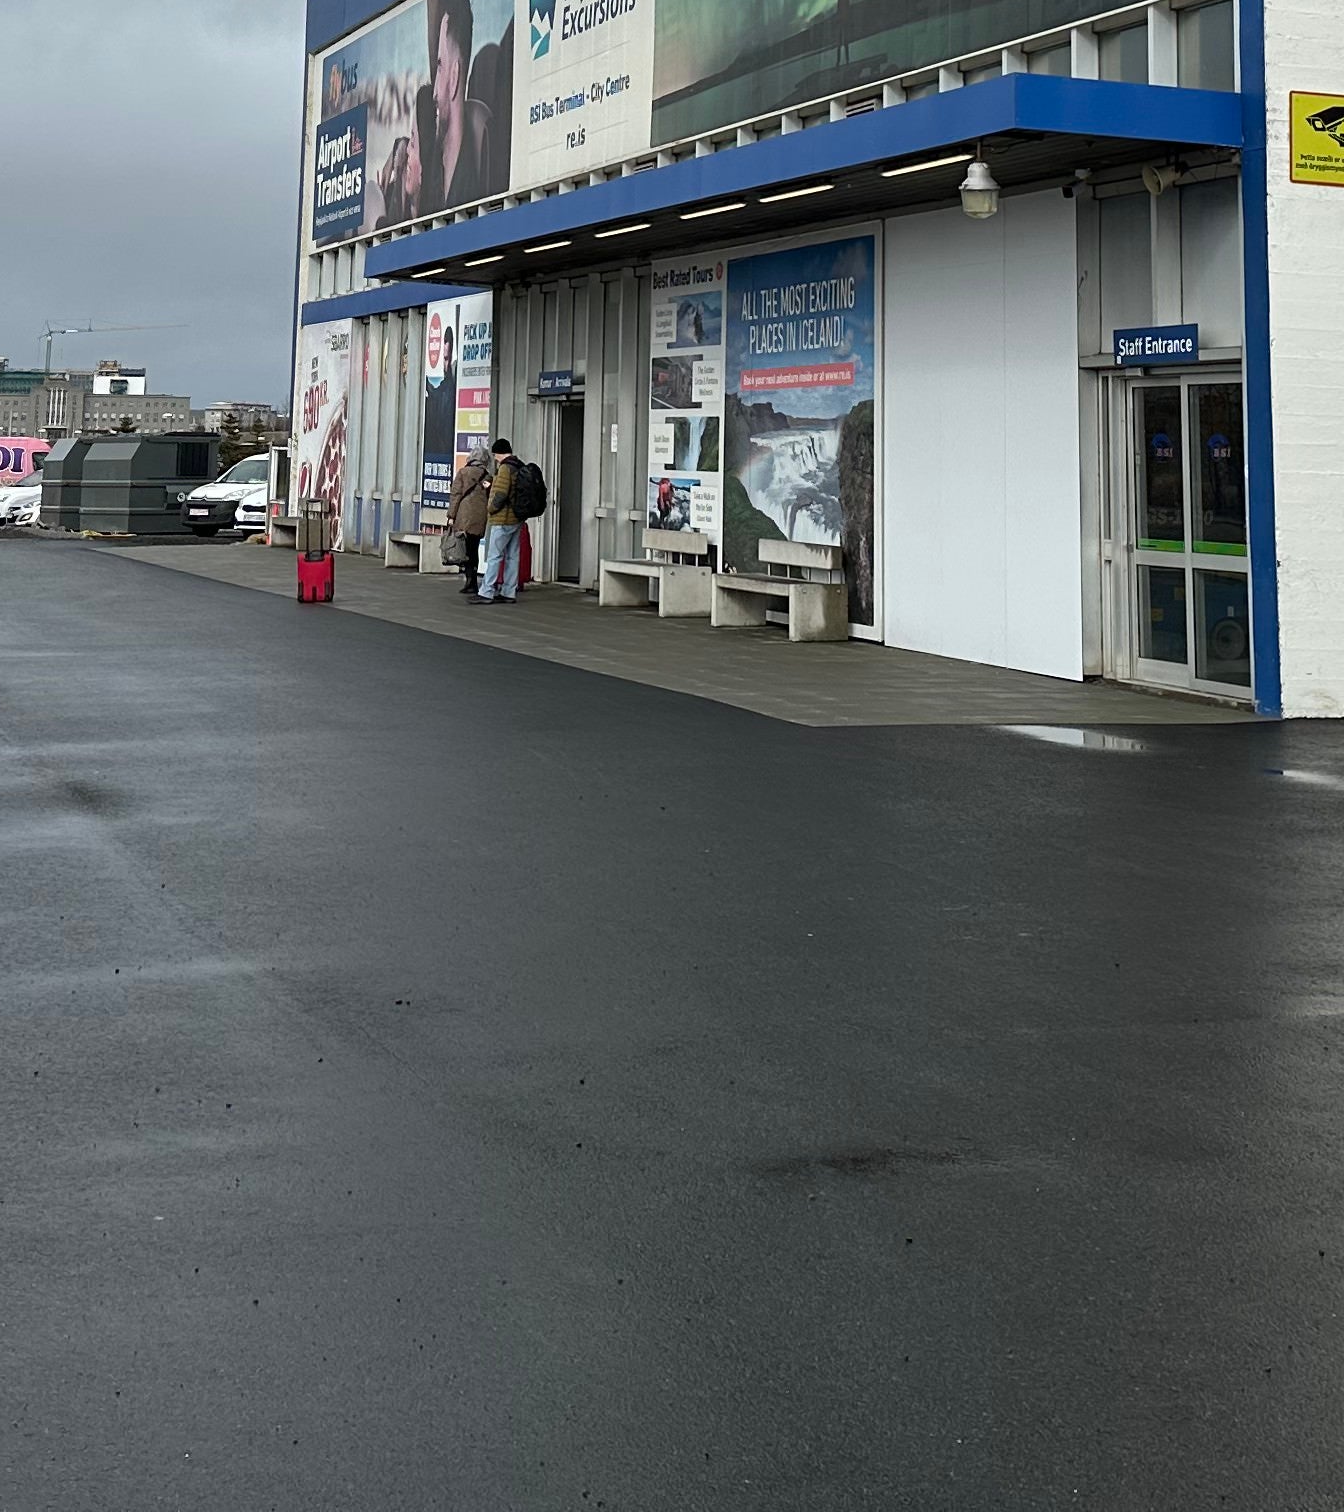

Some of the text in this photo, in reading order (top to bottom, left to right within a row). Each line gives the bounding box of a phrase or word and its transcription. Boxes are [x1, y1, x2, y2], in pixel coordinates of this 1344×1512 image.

[542, 101, 555, 119] Bus
[555, 87, 586, 115] Terminal
[591, 82, 605, 104] City
[605, 73, 630, 97] Centre
[318, 125, 352, 173] Airport
[566, 123, 586, 151] re.is
[317, 164, 362, 208] Transfers
[653, 266, 714, 290] Best Rated Tours
[741, 277, 855, 321] ALL THE MOST EXCITING
[463, 343, 479, 361] DROP
[749, 315, 844, 355] PLACES IN ICELAND!
[1119, 336, 1193, 357] Staff Entrance
